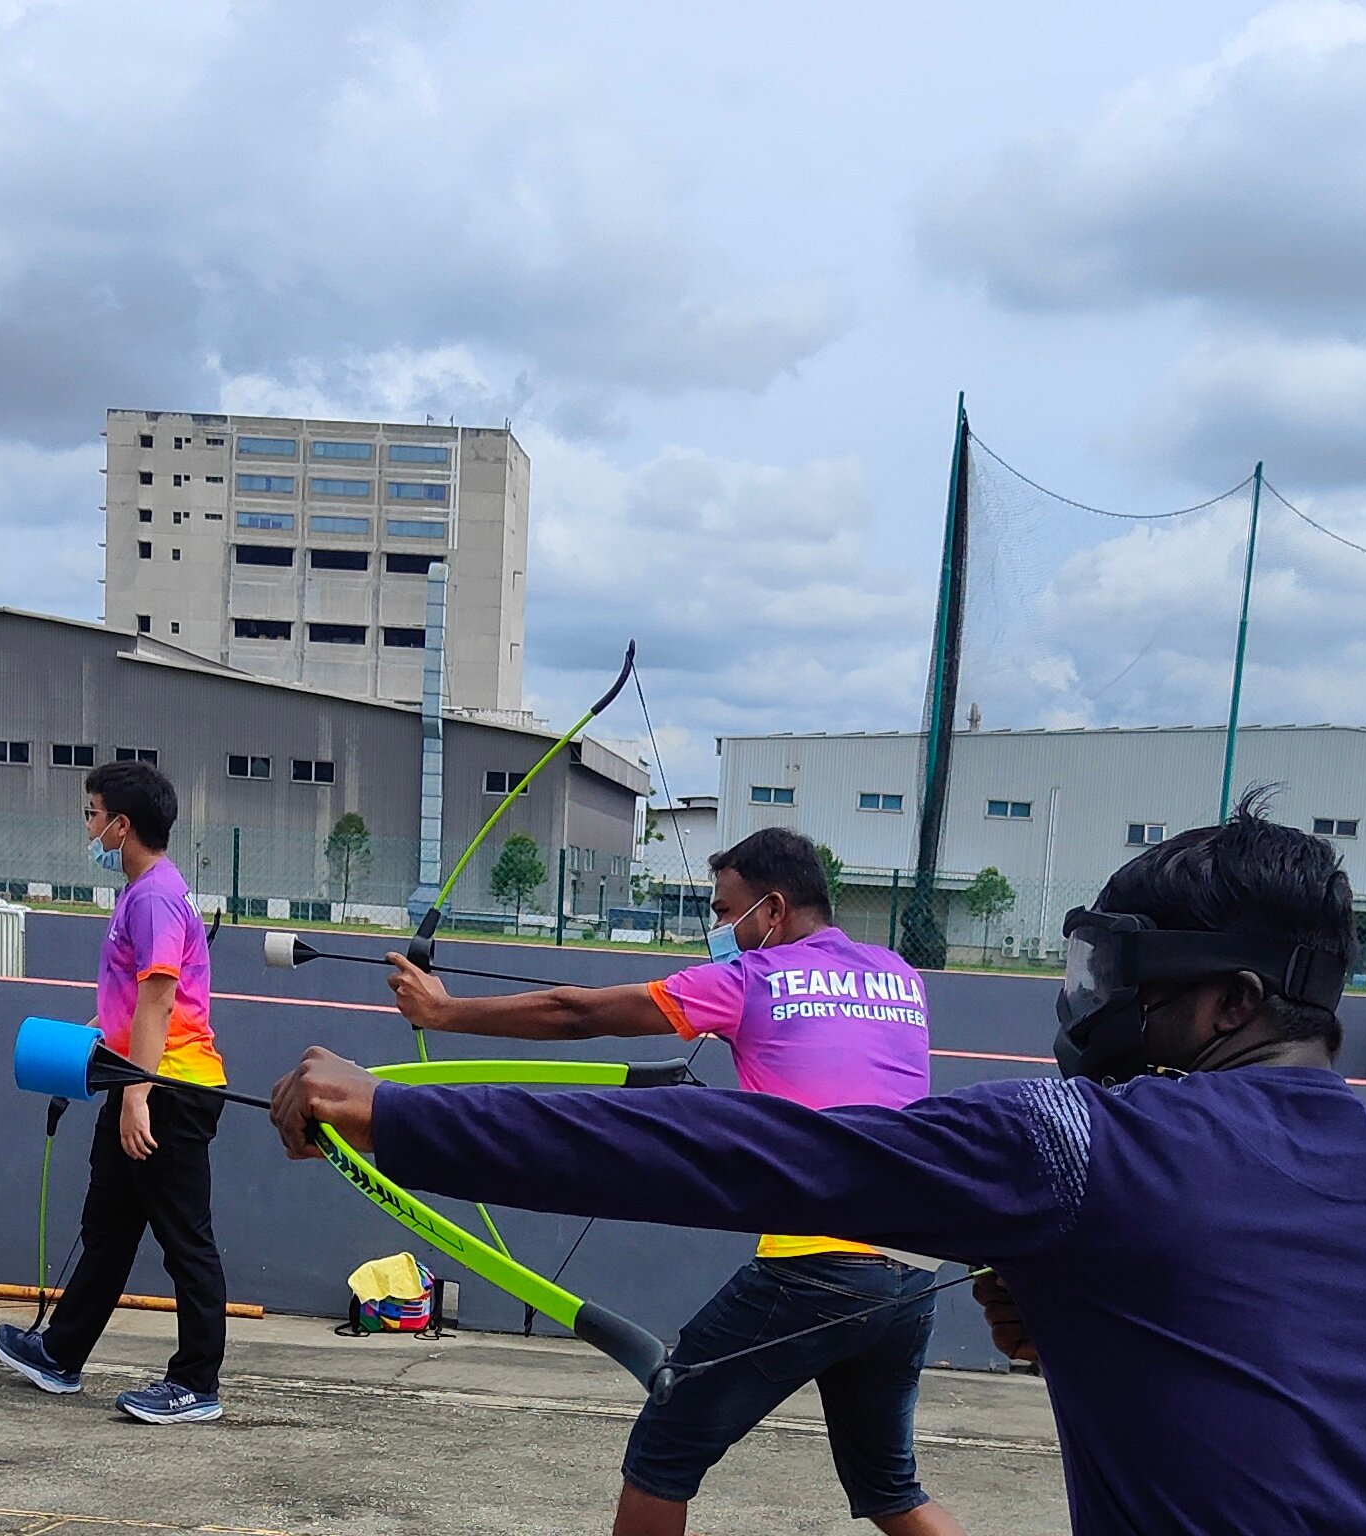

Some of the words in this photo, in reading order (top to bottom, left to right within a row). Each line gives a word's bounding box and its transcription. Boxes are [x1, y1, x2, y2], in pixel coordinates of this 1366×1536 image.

[765, 969, 859, 999] TEAM
[864, 972, 924, 1009] NILA
[772, 1002, 837, 1022] SPORT
